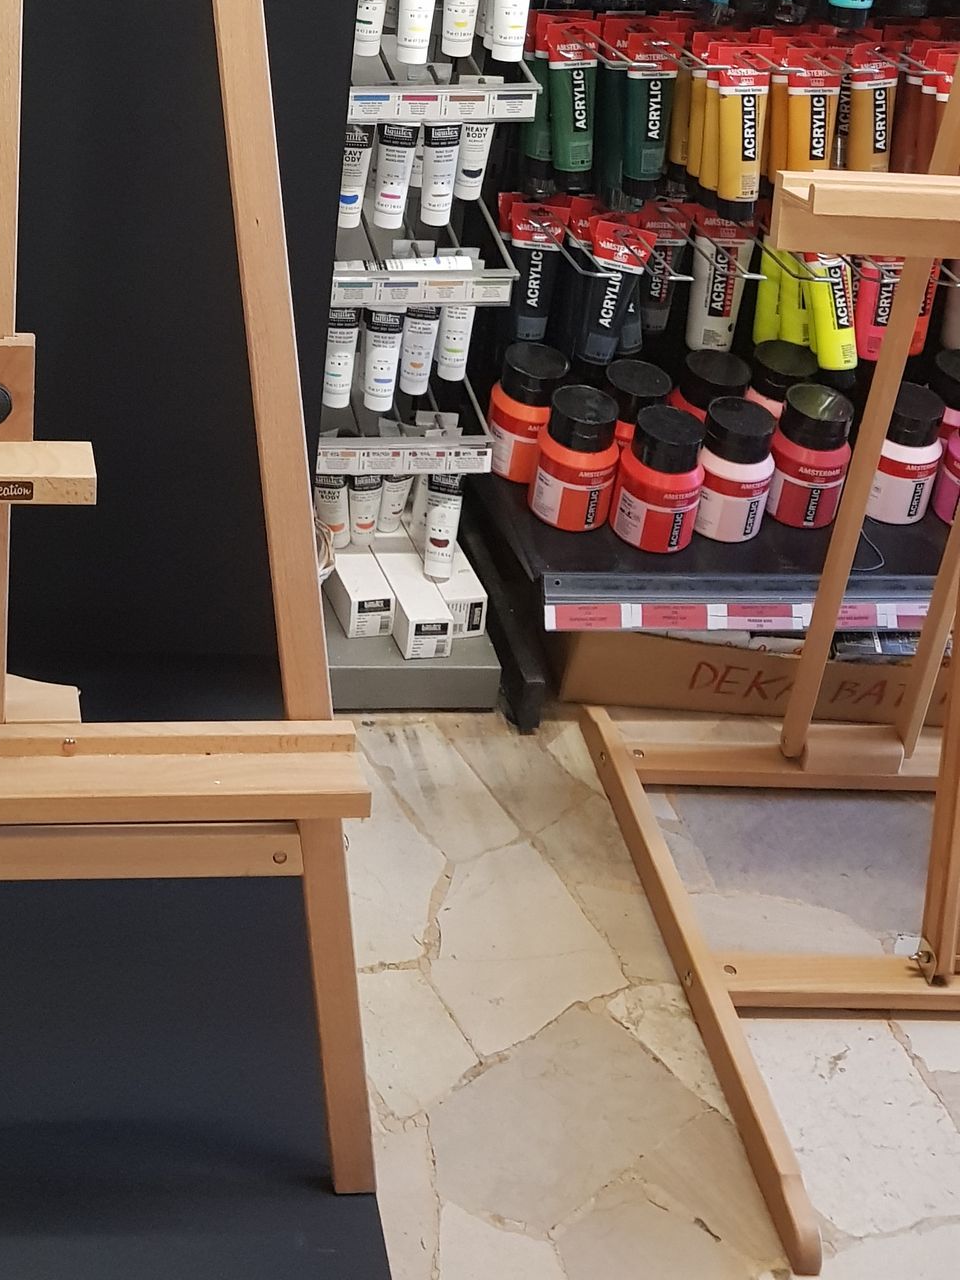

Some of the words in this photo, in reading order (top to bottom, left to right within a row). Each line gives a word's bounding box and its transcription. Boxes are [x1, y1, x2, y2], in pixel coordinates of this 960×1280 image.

[573, 70, 587, 129] ACRYLIC
[648, 80, 661, 139] ACRYLIC
[384, 125, 413, 137] Liquitex
[431, 126, 459, 137] Liquitex
[744, 96, 755, 158] ACRYLIC
[812, 97, 825, 158] ACRYLIC
[876, 90, 885, 149] ACRYLIC
[526, 251, 543, 307] ACRYLIC
[599, 272, 622, 328] ACRYLIC
[798, 466, 841, 478] AMSTERDAM
[587, 490, 599, 523] ACRYLIC
[744, 501, 758, 535] ACRYLIC
[806, 489, 820, 522] ACRYLIC
[910, 484, 924, 516] ACRYLIC
[671, 513, 683, 546] ACRYLIC
[689, 660, 794, 701] DEK
